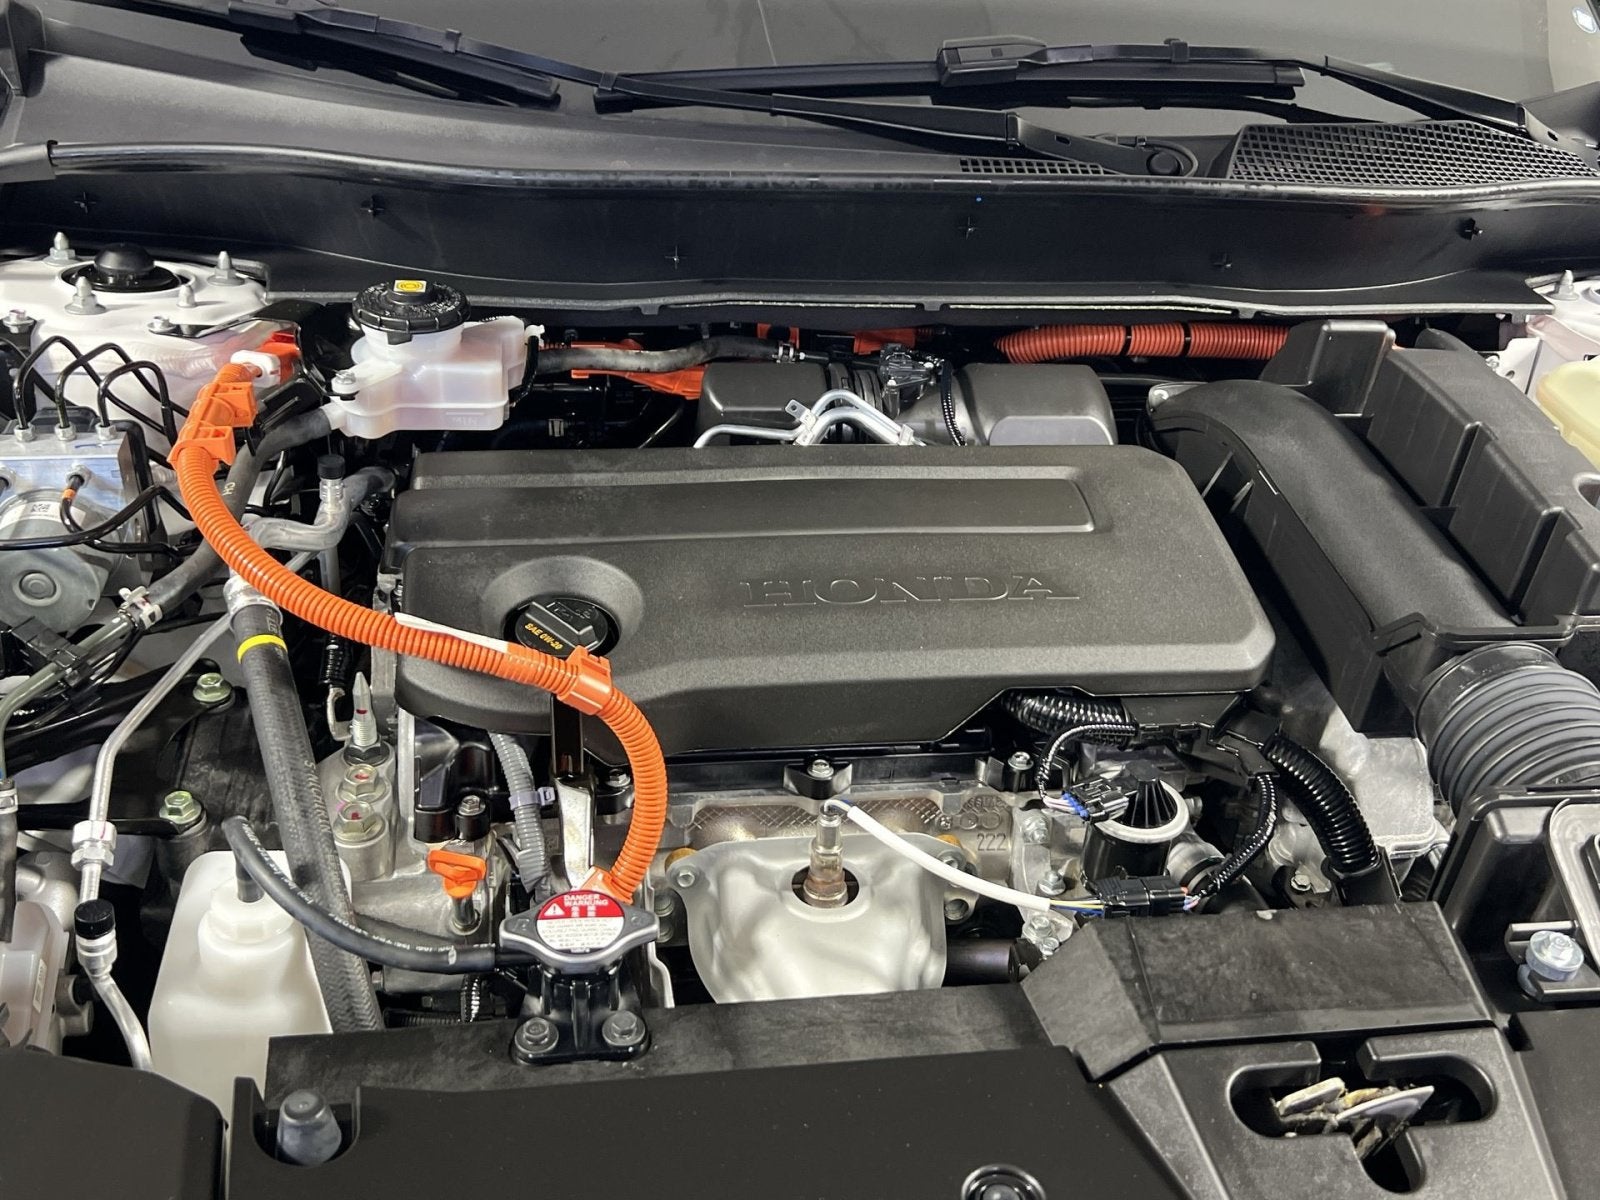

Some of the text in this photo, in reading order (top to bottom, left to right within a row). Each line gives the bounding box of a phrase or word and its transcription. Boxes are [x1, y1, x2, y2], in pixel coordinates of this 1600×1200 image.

[739, 575, 1080, 607] HONDA
[524, 622, 564, 650] SAE 0W-20
[977, 833, 1006, 851] 222
